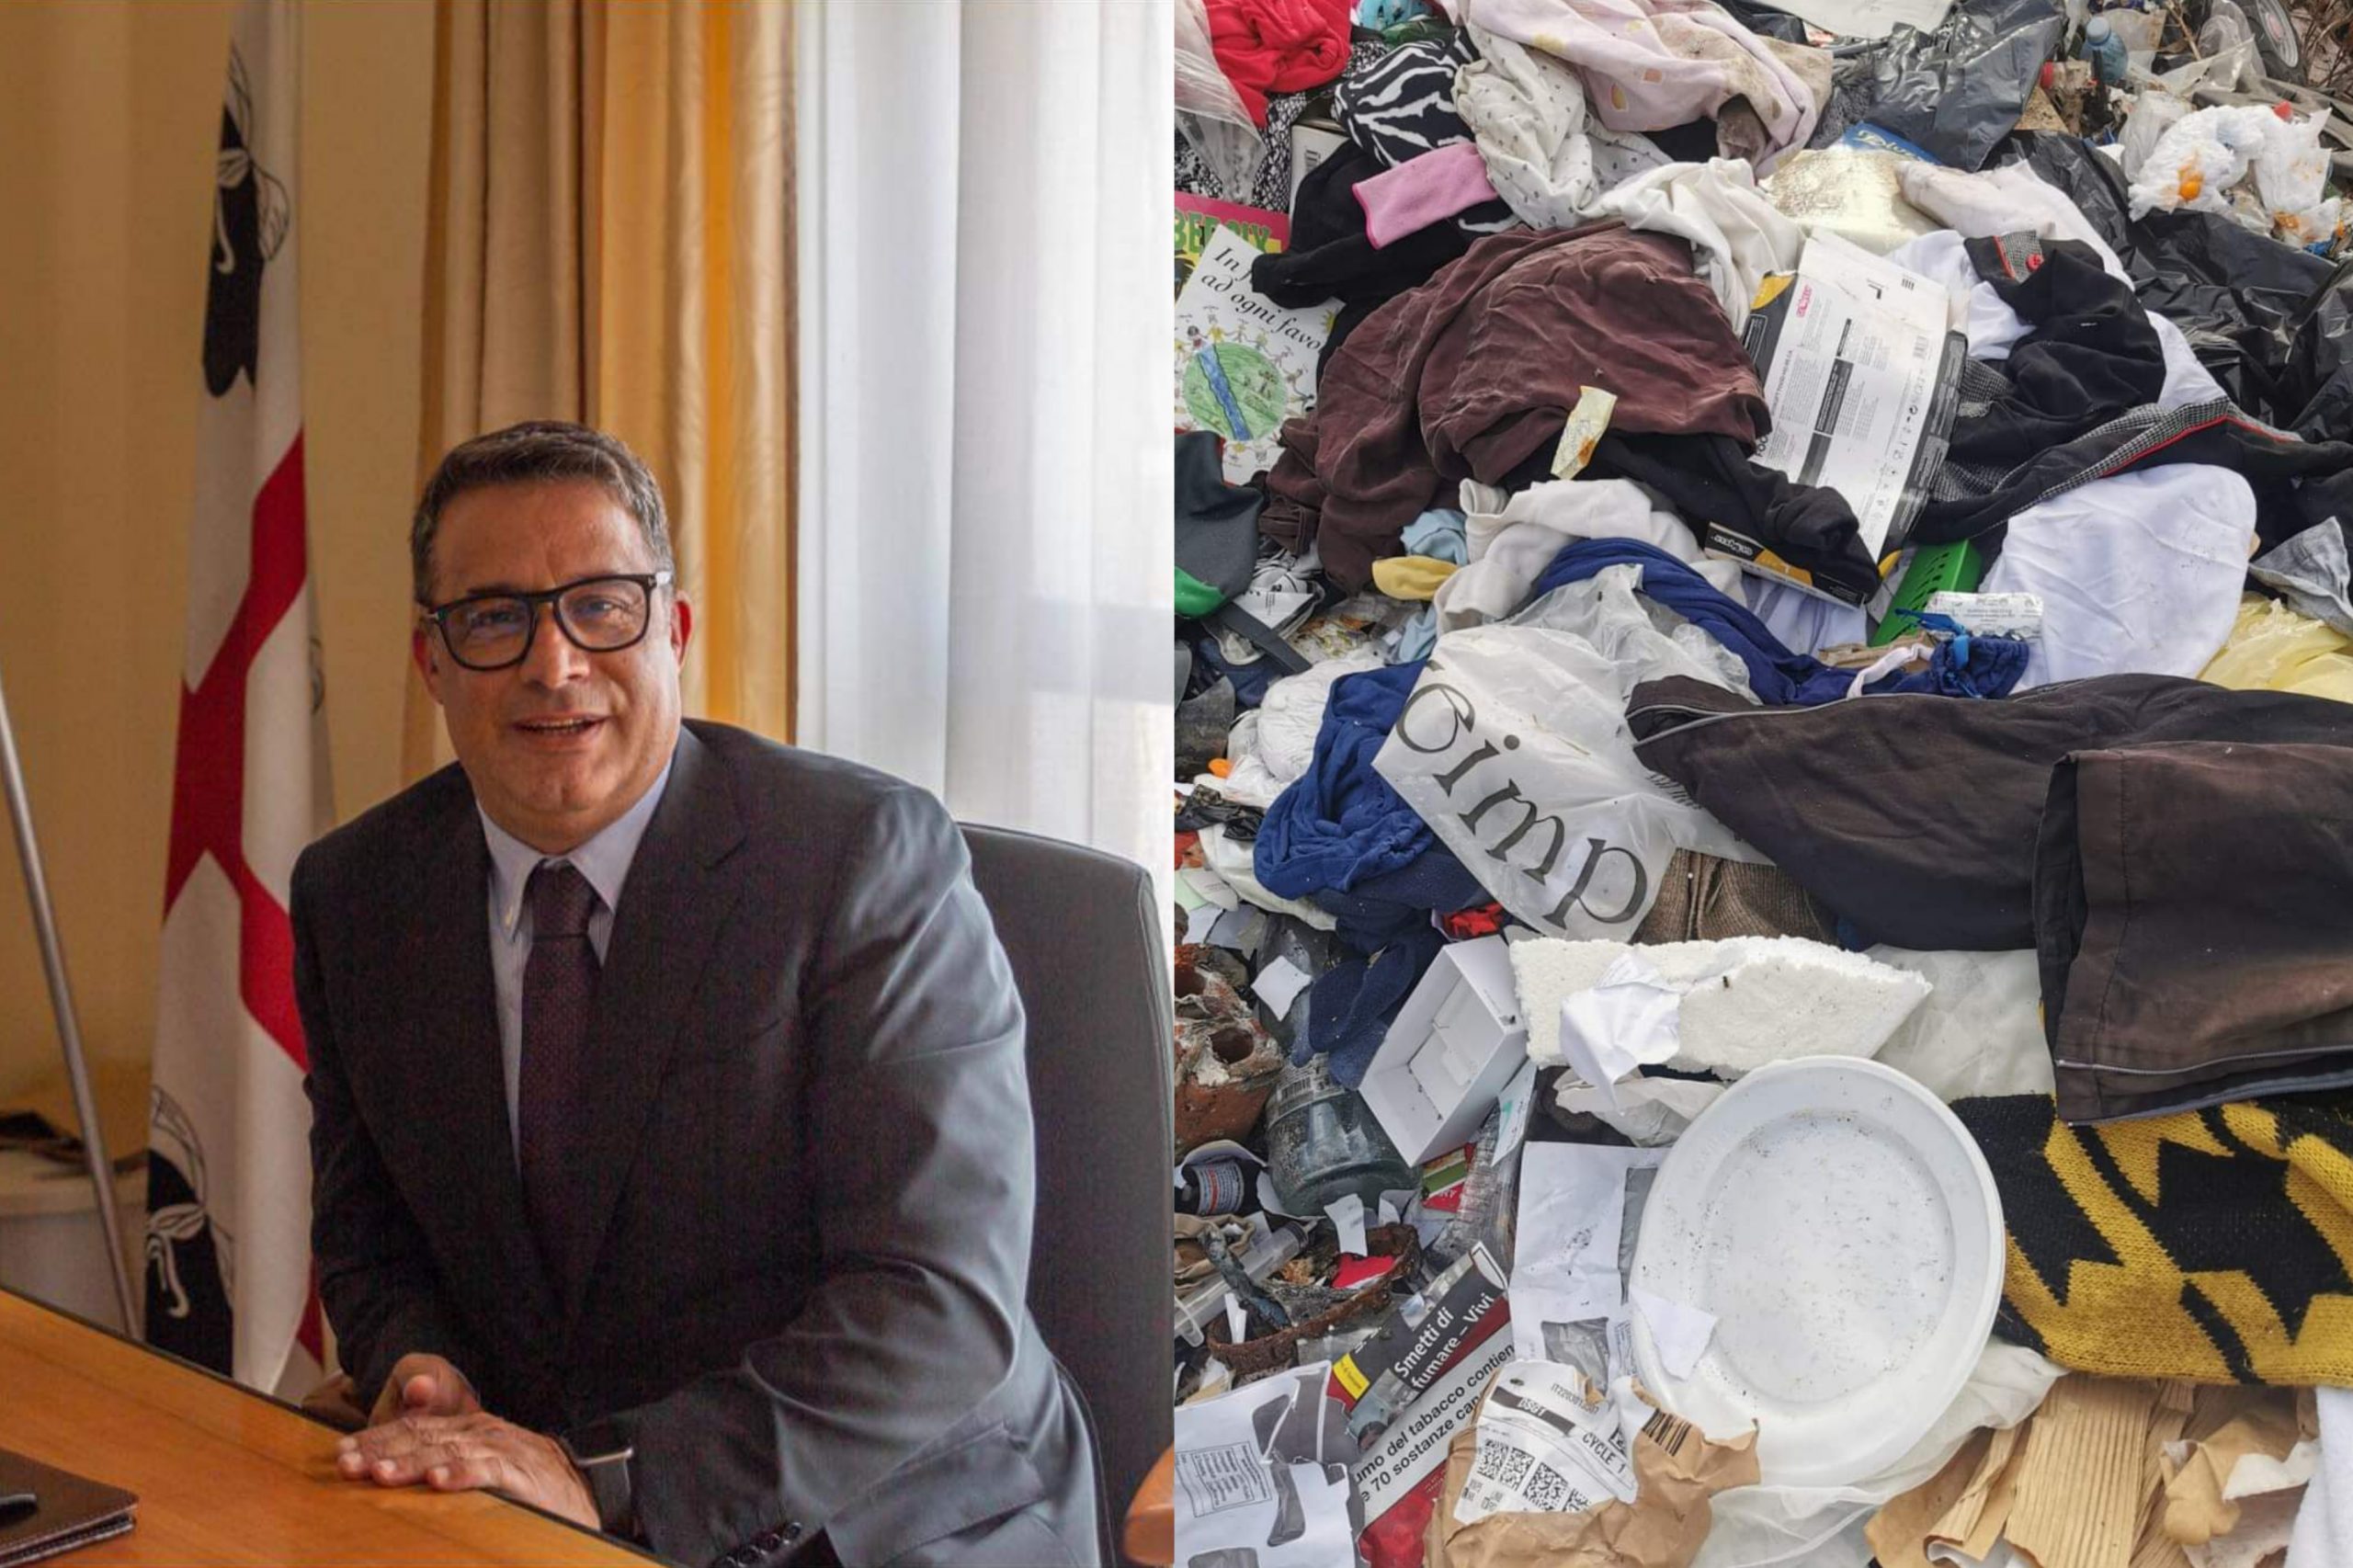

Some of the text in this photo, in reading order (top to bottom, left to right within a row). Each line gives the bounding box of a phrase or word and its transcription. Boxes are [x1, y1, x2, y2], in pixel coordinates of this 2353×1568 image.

[1213, 246, 1240, 272] In
[1230, 292, 1283, 324] ogni
[1270, 317, 1324, 351] favo
[1755, 435, 1768, 458] FOO
[1393, 1305, 1456, 1379] Smetti di
[1411, 1335, 1461, 1392] fumare
[1462, 1291, 1495, 1324] Vivi
[1387, 1430, 1411, 1458] del
[1408, 1385, 1465, 1437] tabacco
[1467, 1343, 1515, 1387] contien
[1370, 1471, 1391, 1492] 70
[1394, 1418, 1455, 1478] sostanze
[1582, 1431, 1627, 1474] CYCLE 1
